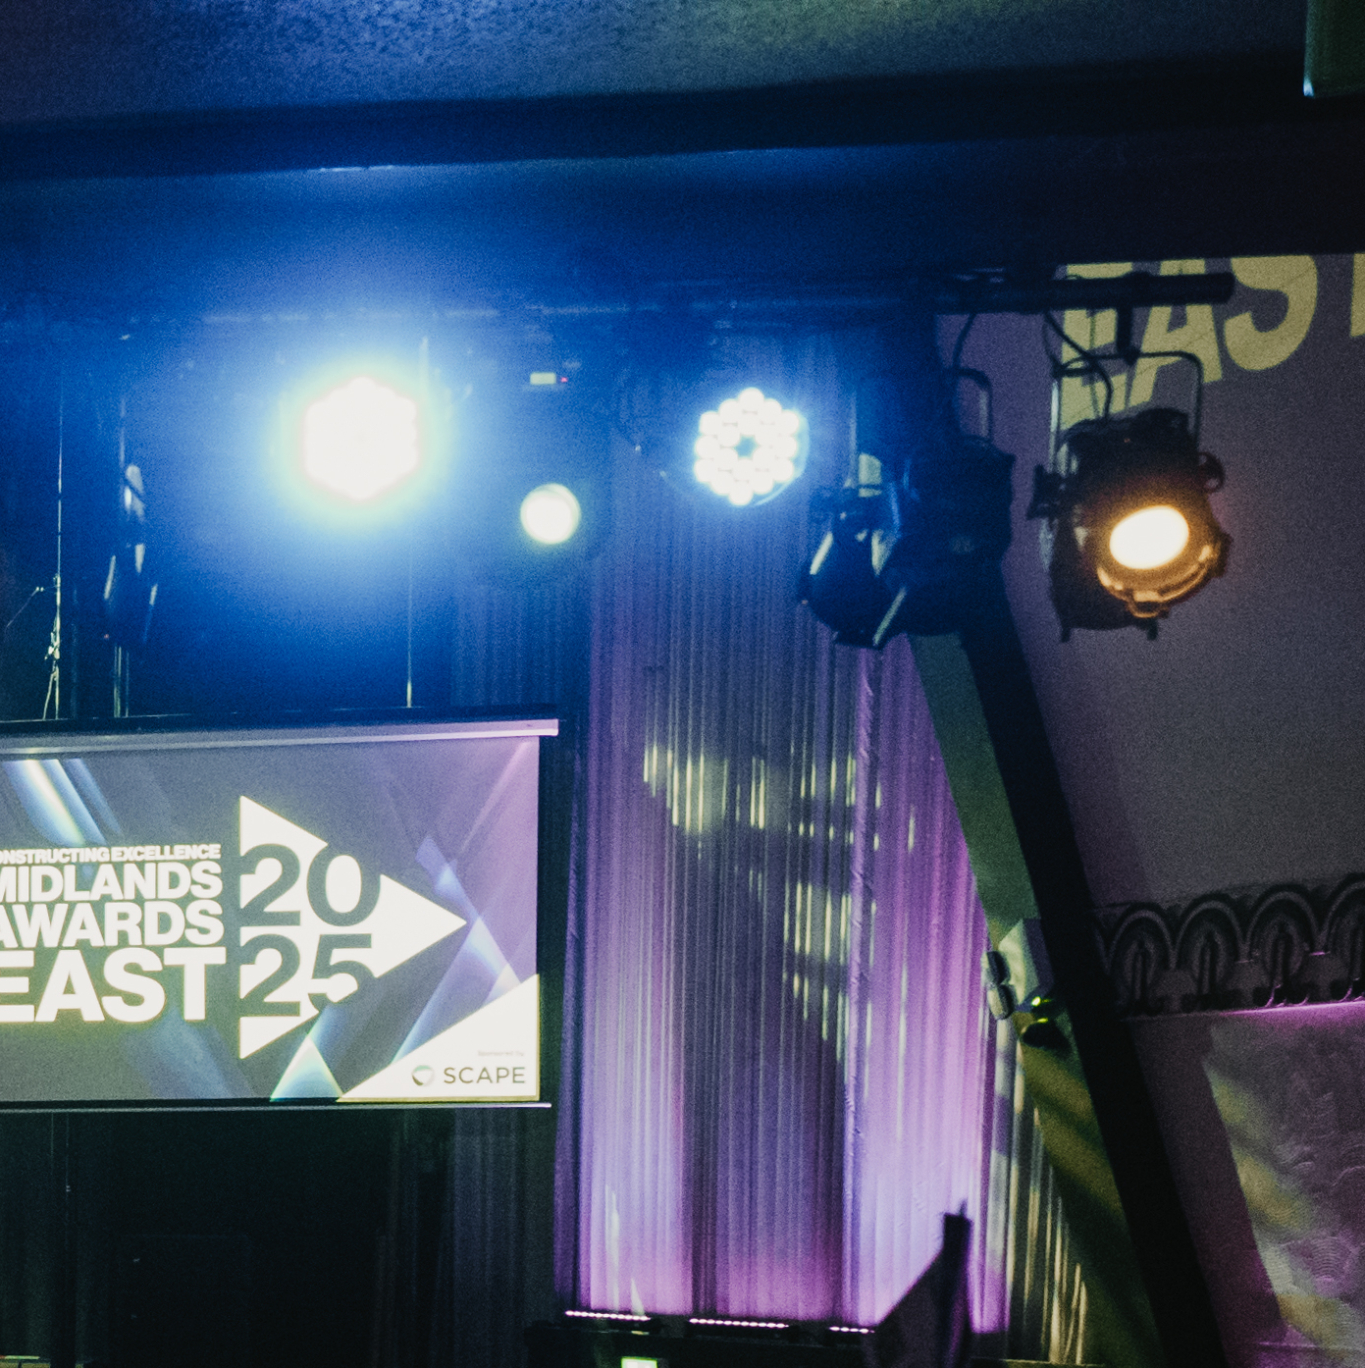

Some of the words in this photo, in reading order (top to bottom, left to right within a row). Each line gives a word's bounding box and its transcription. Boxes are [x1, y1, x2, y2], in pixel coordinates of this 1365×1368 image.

[1059, 252, 1365, 431] EAS
[111, 844, 221, 861] EXCELLENCE
[239, 843, 381, 927] 20
[239, 933, 376, 1017] 25
[443, 1066, 525, 1085] SCAPE
